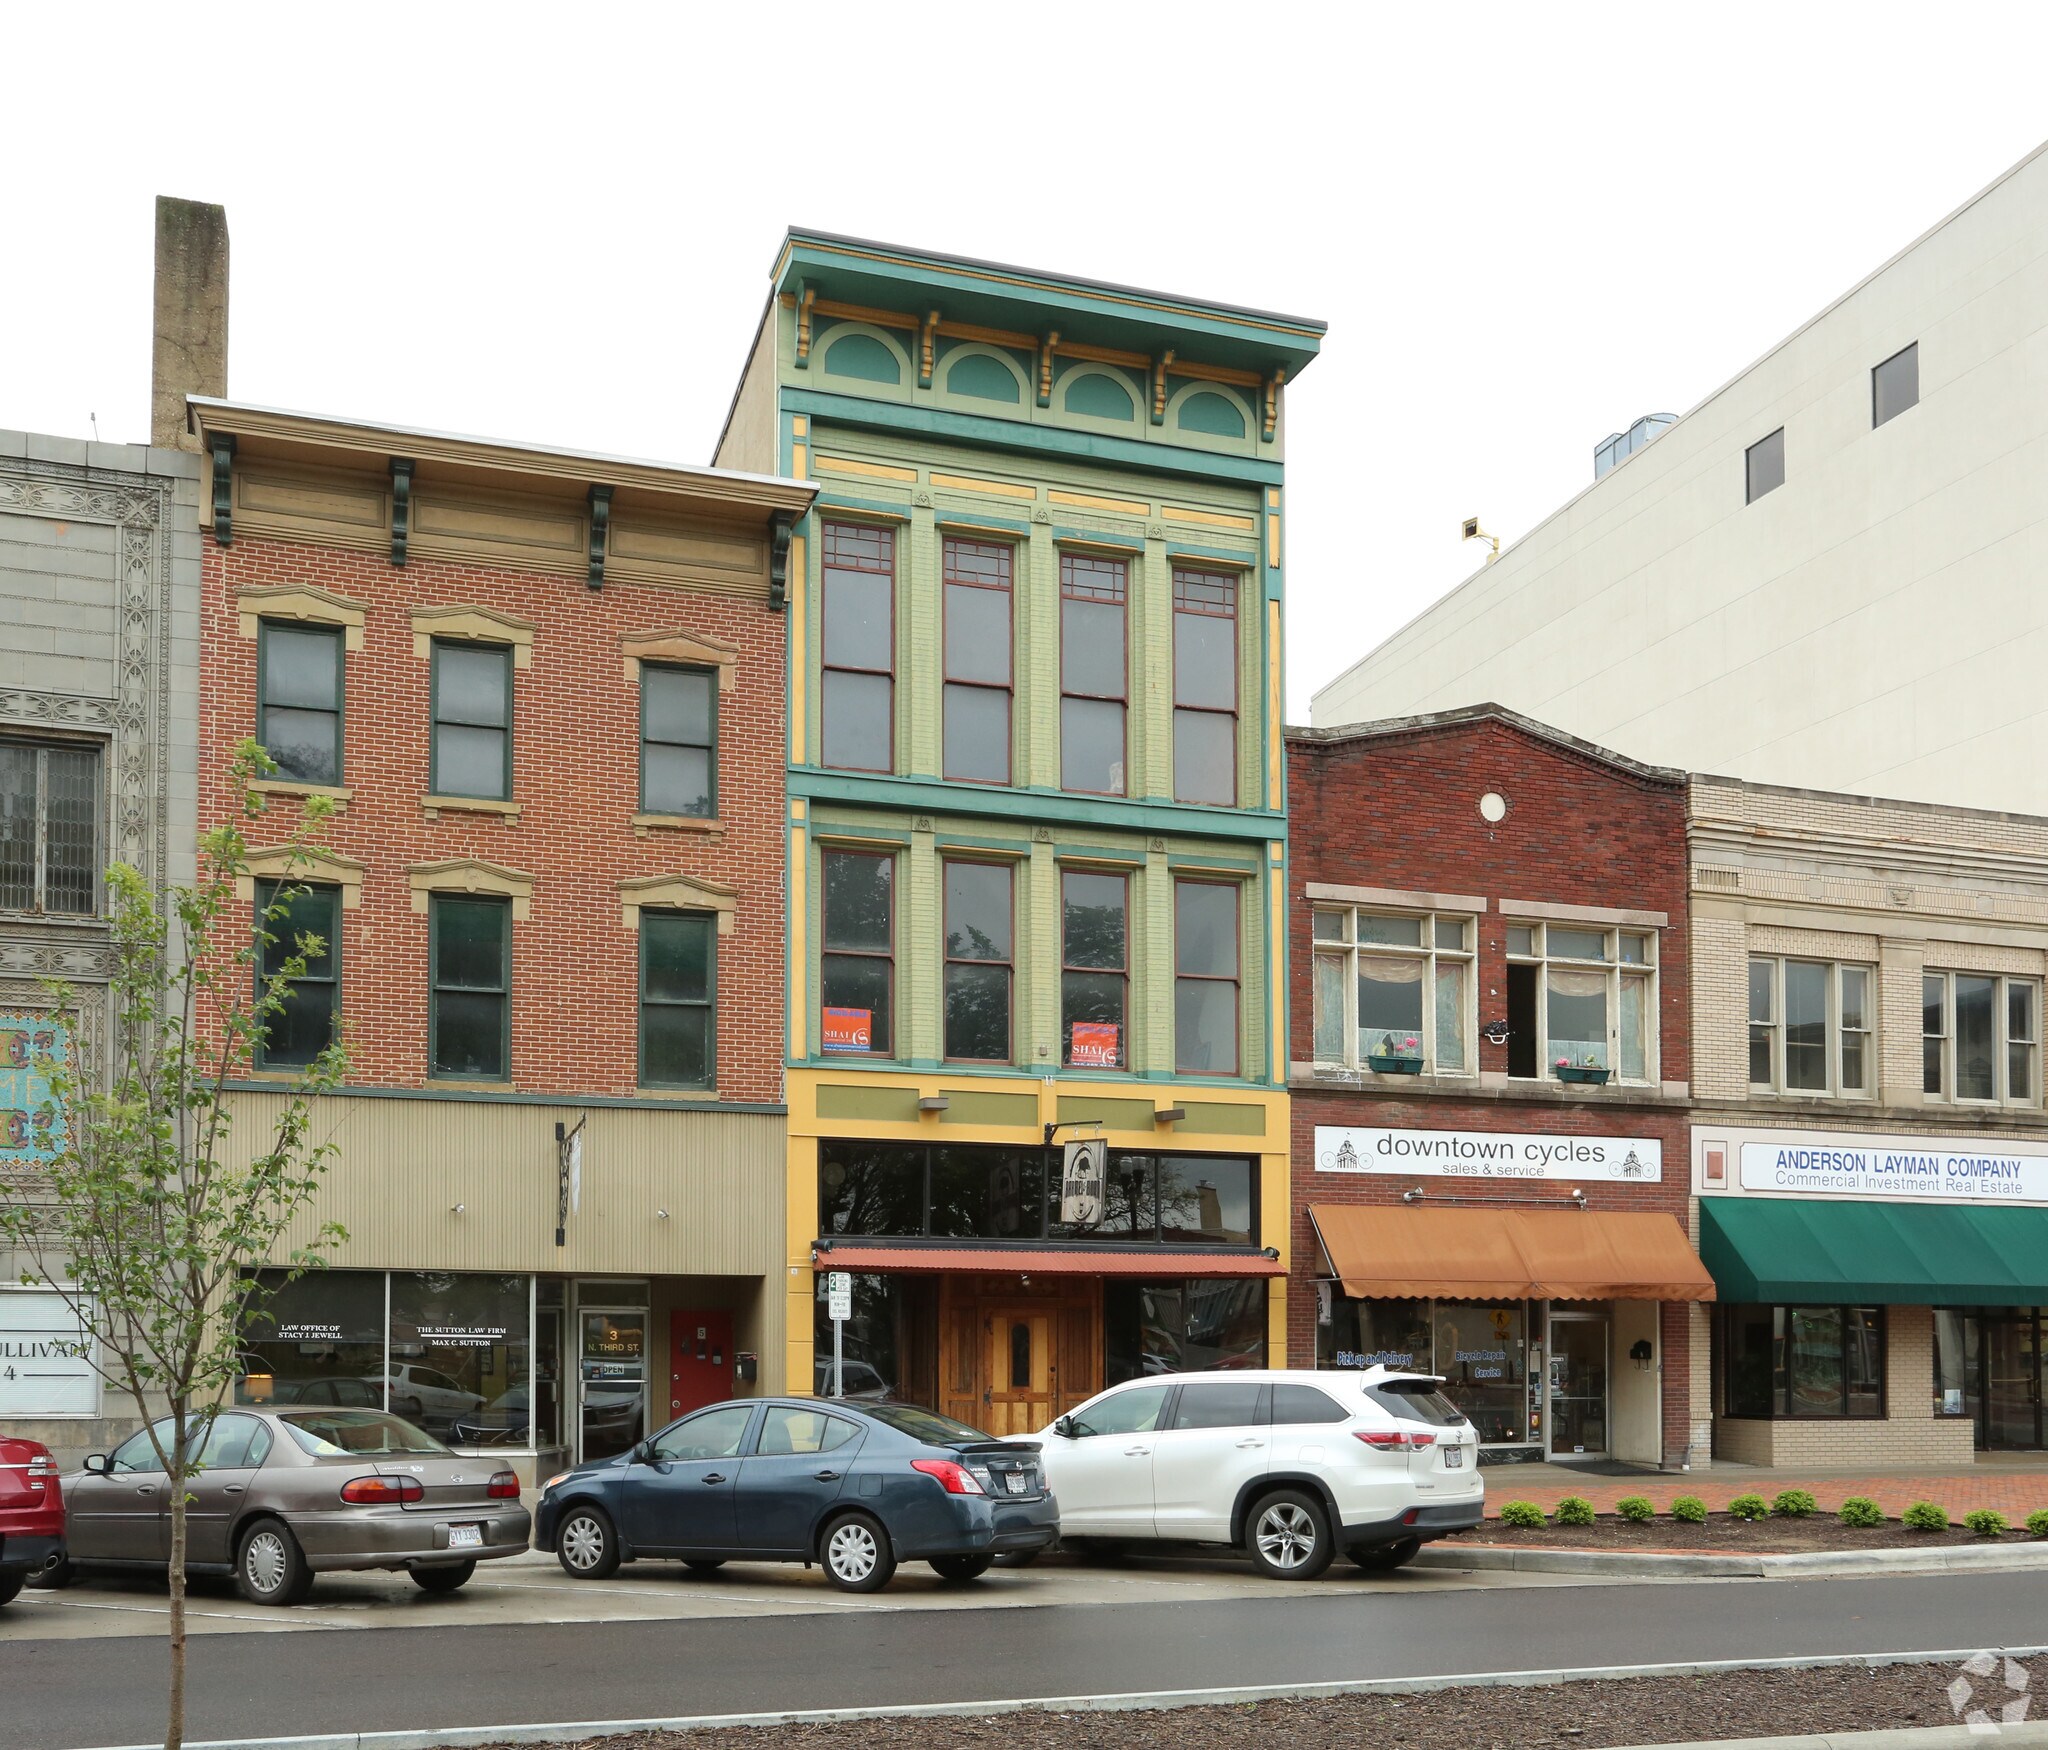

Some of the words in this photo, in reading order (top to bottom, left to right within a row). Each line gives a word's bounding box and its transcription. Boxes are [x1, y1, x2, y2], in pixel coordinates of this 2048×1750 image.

[824, 1031, 849, 1039] SHAI
[1073, 1045, 1102, 1054] SHAI
[1377, 1134, 1514, 1160] downtown
[1524, 1141, 1605, 1166] cycles
[1442, 1162, 1479, 1175] sales
[1482, 1164, 1493, 1175] &
[1497, 1164, 1545, 1177] service
[1776, 1150, 1866, 1172] ANDERSON
[1874, 1154, 1940, 1176] LAYMAN
[1947, 1158, 2021, 1179] COMPANY
[1775, 1170, 1860, 1187] Commercial
[1865, 1175, 1940, 1191] Investment
[1946, 1177, 1976, 1192] Real
[1981, 1179, 2023, 1194] Estate
[830, 1276, 836, 1288] 2
[609, 1330, 618, 1341] 3
[699, 1329, 704, 1337] 5
[627, 1344, 640, 1352] ST.
[1337, 1351, 1355, 1366] Pick
[1355, 1355, 1366, 1368] up
[1366, 1351, 1380, 1365] and
[1381, 1351, 1413, 1367] Delivery
[1455, 1350, 1482, 1363] Bicycle
[1482, 1349, 1506, 1362] Repair
[3, 1365, 17, 1380] 4
[1475, 1367, 1501, 1378] Service
[1018, 1393, 1025, 1401] 5
[463, 1528, 480, 1540] 3302
